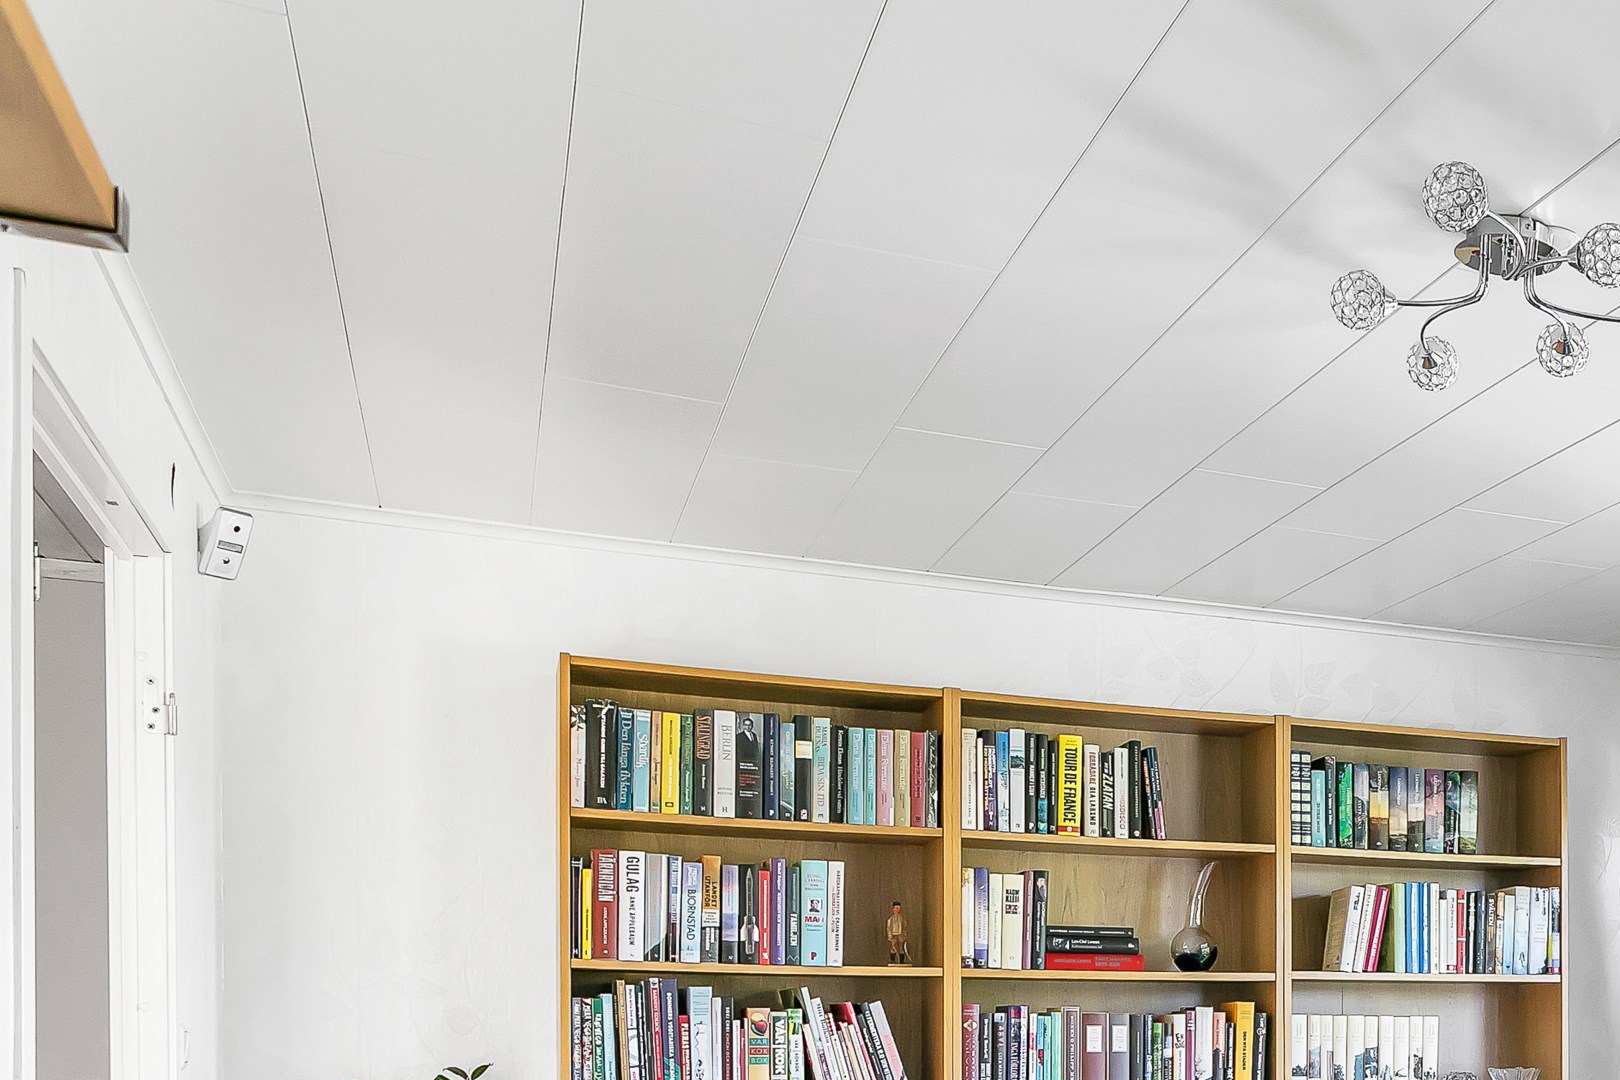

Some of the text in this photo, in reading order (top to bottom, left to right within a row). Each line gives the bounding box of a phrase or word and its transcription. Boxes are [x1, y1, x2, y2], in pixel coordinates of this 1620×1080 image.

[621, 721, 632, 740] Den
[696, 716, 712, 759] STALINGRAD
[721, 725, 733, 760] BERLIN
[619, 770, 630, 803] flykten
[1064, 748, 1077, 824] TOUR DE FRANCE
[1103, 774, 1113, 809] ZLATAN
[598, 854, 614, 902] JÄRNRIDÅN
[626, 856, 639, 892] GULAG
[628, 912, 636, 946] APPLEBAUM
[774, 1048, 785, 1075] KOK
